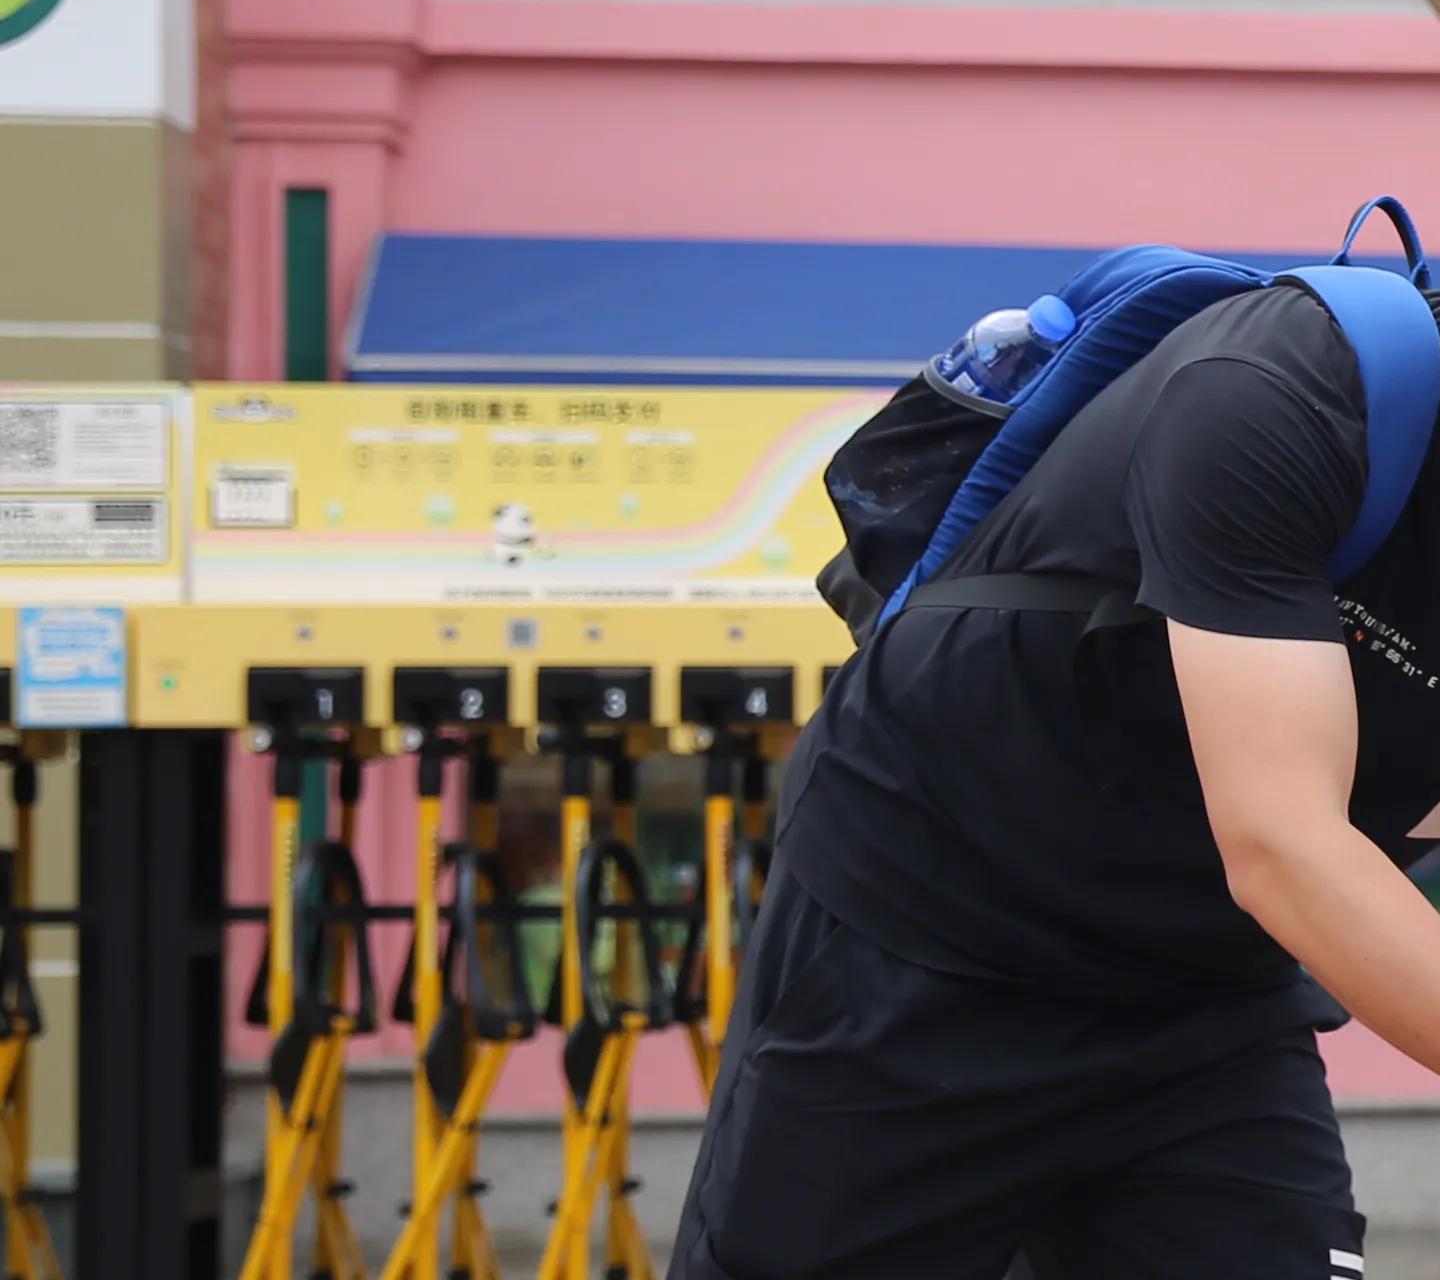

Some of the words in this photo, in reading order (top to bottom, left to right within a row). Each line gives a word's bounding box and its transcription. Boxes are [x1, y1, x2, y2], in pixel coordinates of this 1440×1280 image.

[460, 687, 485, 720] 2
[602, 687, 628, 719] 3
[745, 686, 768, 717] 4
